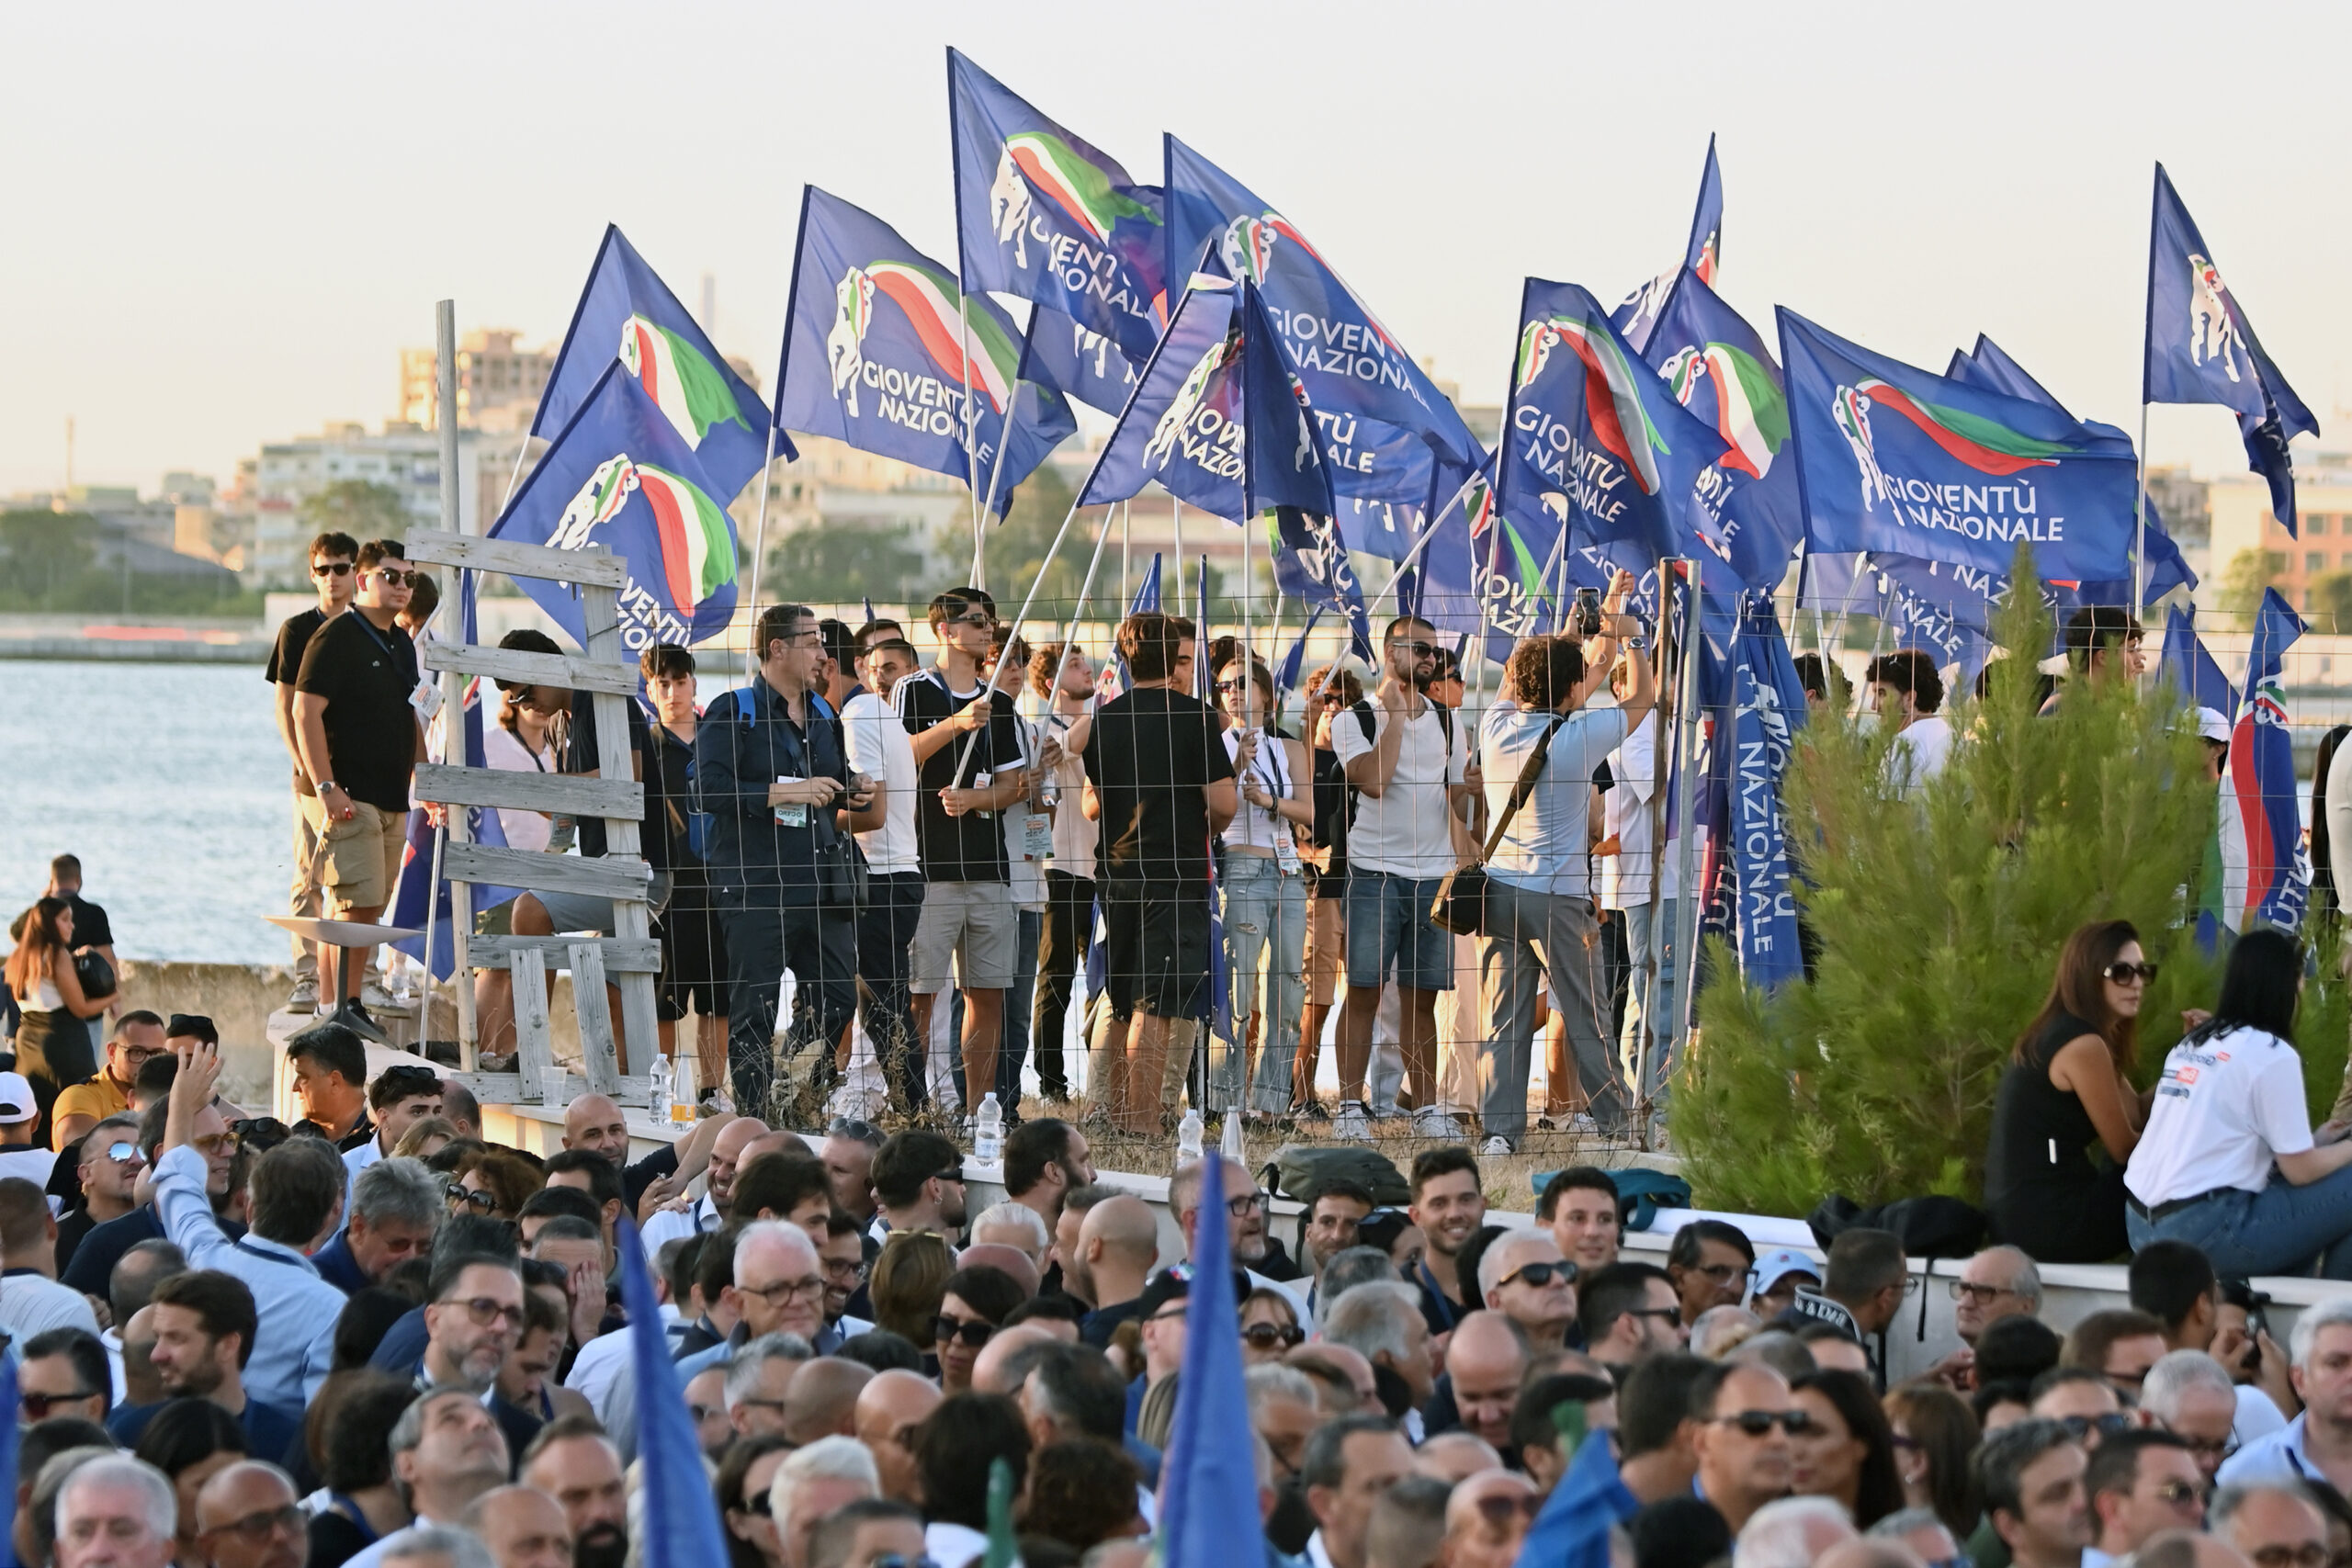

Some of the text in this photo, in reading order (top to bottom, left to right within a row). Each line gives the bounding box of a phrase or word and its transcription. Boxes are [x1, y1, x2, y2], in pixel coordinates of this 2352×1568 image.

[1884, 473, 2036, 514] GIOVENTÙ
[1906, 504, 2064, 542] NAZIONALE
[1738, 741, 1773, 954] NAZIONALE
